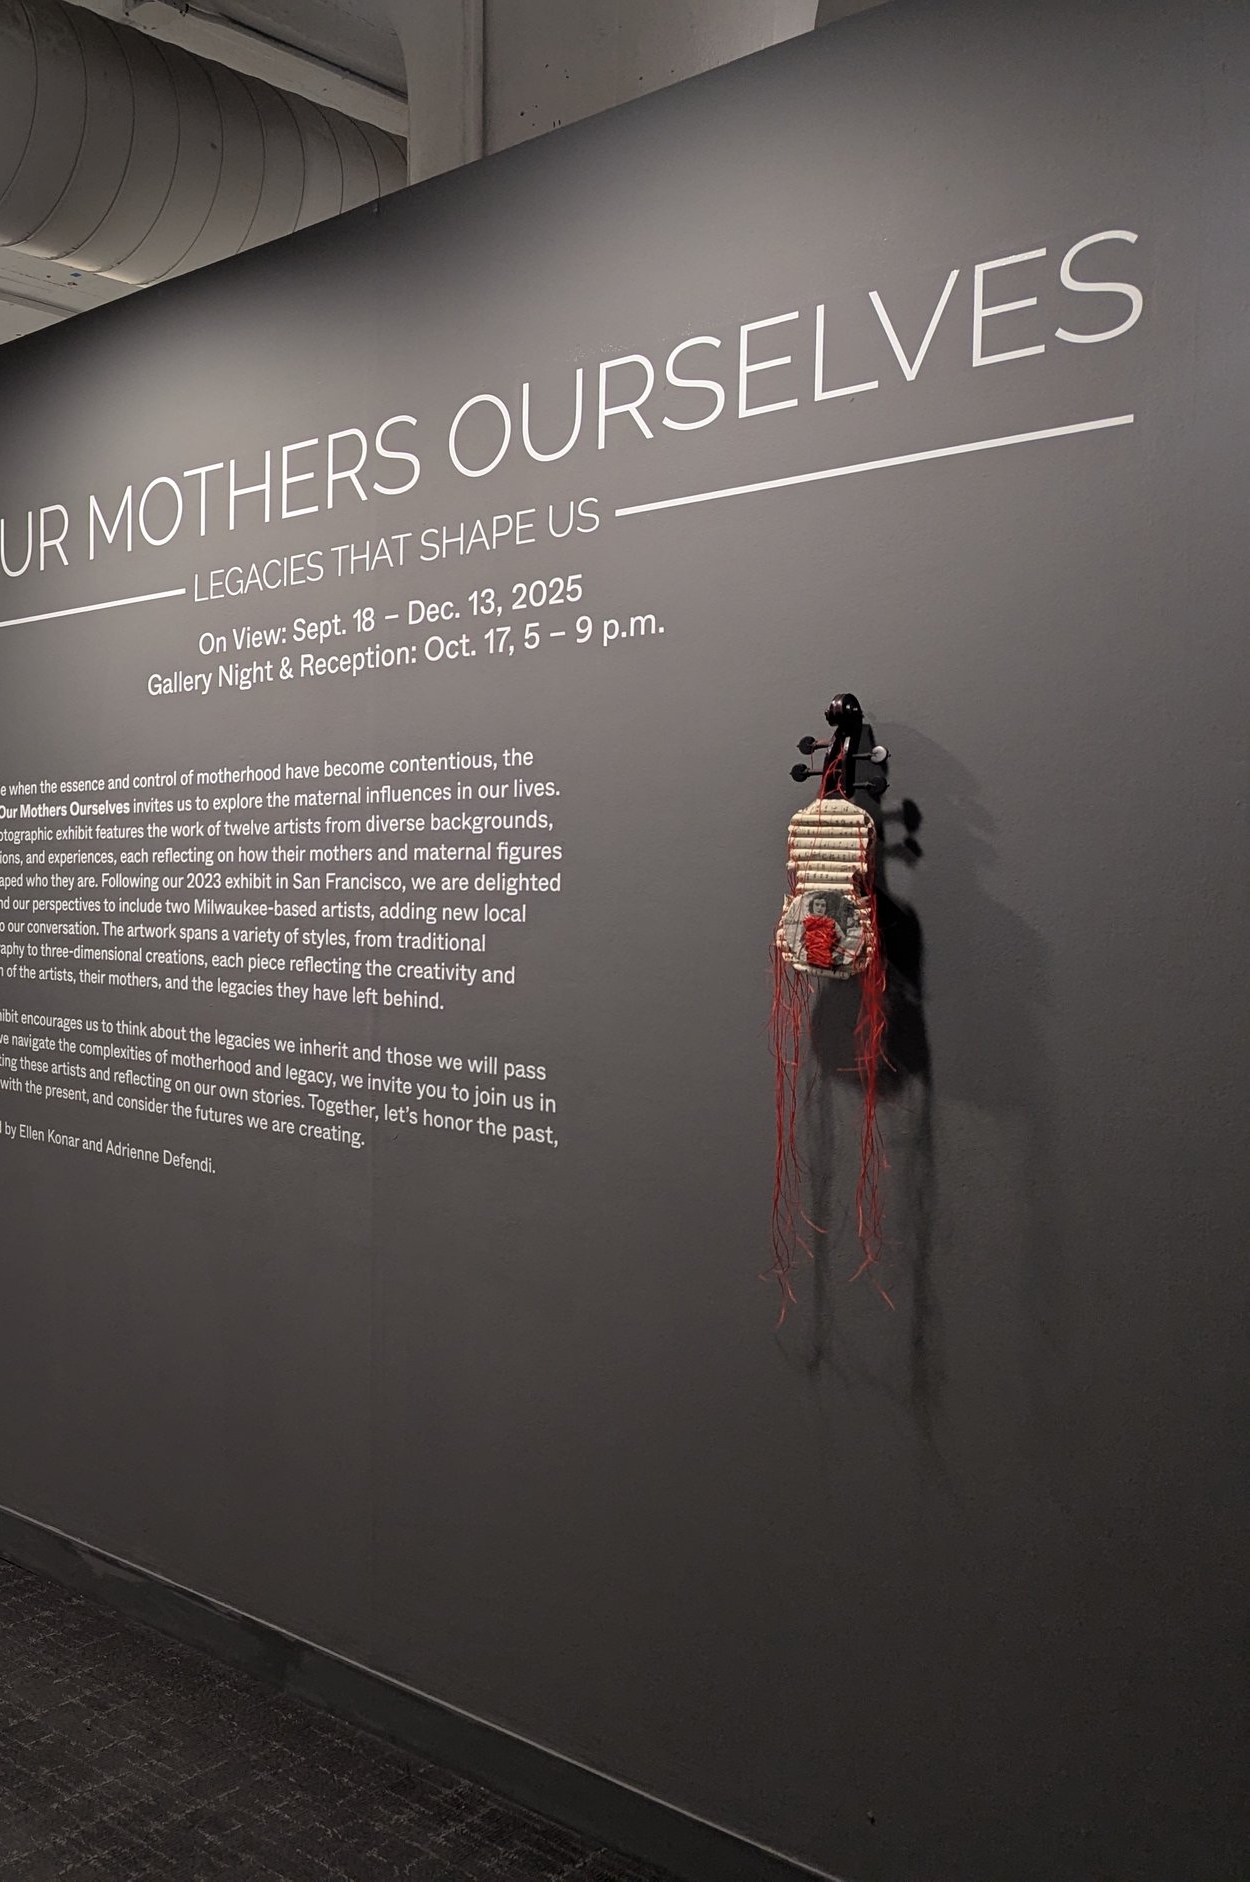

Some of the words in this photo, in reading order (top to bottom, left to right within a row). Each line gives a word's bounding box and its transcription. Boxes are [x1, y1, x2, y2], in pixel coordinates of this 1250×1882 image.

[90, 415, 420, 560] MOTHERS
[449, 230, 1143, 477] OURSELVES
[195, 551, 323, 602] LEGACIES
[331, 533, 412, 576] THAT
[420, 508, 536, 561] SHAPE
[549, 497, 599, 537] US
[199, 633, 226, 655] On
[233, 626, 286, 650] View:
[293, 614, 346, 644] Sept.
[353, 607, 375, 632] 18
[409, 600, 460, 625] Dec.
[468, 588, 502, 617] 13,
[512, 574, 582, 610] 2025
[148, 671, 212, 695] Gallery
[219, 661, 273, 690] Night
[279, 657, 294, 680] &
[301, 644, 416, 677] Reception:
[425, 634, 476, 661] Oct.
[484, 626, 514, 656] 17,
[524, 622, 540, 649] 5
[576, 616, 592, 643] 9
[603, 614, 664, 646] p.m.
[9, 781, 37, 795] when
[40, 780, 57, 794] the
[60, 779, 105, 793] essence
[108, 774, 129, 790] and
[133, 771, 176, 788] control
[180, 769, 194, 785] of
[197, 764, 281, 784] motherhood
[286, 763, 319, 779] have
[324, 760, 384, 777] become
[390, 751, 497, 773] contentious,
[502, 748, 533, 766] the
[20, 803, 67, 818] Mothers
[70, 800, 130, 816] Ourselves
[133, 798, 173, 813] invites
[177, 799, 192, 811] us
[195, 796, 209, 810] to
[213, 793, 263, 813] explore
[266, 791, 290, 807] the
[295, 787, 361, 806] maternal
[366, 785, 451, 803] influences
[457, 782, 472, 799] in
[478, 784, 509, 799] our
[514, 779, 560, 797] lives.
[56, 825, 93, 840] exhibit
[95, 825, 144, 839] features
[147, 823, 167, 838] the
[171, 821, 204, 837] work
[207, 820, 221, 836] of
[224, 819, 270, 835] twelve
[274, 818, 321, 834] artists
[325, 817, 361, 833] from
[366, 815, 425, 832] diverse
[431, 810, 553, 834] backgrounds,
[26, 850, 45, 864] and
[48, 849, 117, 867] experiences,
[120, 848, 148, 863] each
[152, 847, 214, 866] reflecting
[217, 851, 234, 862] on
[239, 846, 268, 862] how
[271, 845, 306, 862] their
[310, 844, 373, 861] mothers
[378, 843, 408, 861] and
[414, 842, 491, 860] maternal
[496, 842, 562, 864] figures
[13, 899, 30, 910] our
[33, 897, 101, 914] perspectives
[103, 898, 116, 912] to
[119, 897, 162, 913] include
[165, 899, 190, 914] two
[194, 899, 316, 917] Milwaukee-based
[322, 901, 374, 921] artists,
[380, 902, 437, 924] adding
[443, 907, 479, 921] new
[485, 903, 526, 922] local
[7, 964, 17, 977] of
[19, 965, 36, 979] the
[39, 967, 76, 984] artists,
[79, 969, 106, 984] their
[109, 972, 161, 989] mothers,
[165, 975, 188, 990] and
[191, 976, 213, 992] the
[218, 977, 273, 998] legacies
[276, 982, 309, 1003] they
[313, 984, 347, 1002] have
[353, 986, 378, 1005] left
[384, 988, 444, 1009] behind.
[27, 943, 38, 956] to
[40, 943, 142, 962] three-dimensional
[145, 949, 208, 968] creations,
[212, 952, 243, 968] each
[248, 953, 285, 972] piece
[290, 956, 362, 979] reflecting
[365, 959, 392, 977] the
[397, 962, 477, 986] creativity
[482, 966, 515, 984] and
[12, 1034, 55, 1052] navigate
[58, 1038, 76, 1053] the
[79, 1043, 152, 1062] complexities
[155, 1049, 168, 1064] of
[171, 1053, 251, 1074] motherhood
[255, 1062, 281, 1078] and
[286, 1064, 336, 1088] legacy,
[340, 1074, 363, 1088] we
[368, 1073, 412, 1094] invite
[416, 1083, 446, 1100] you
[451, 1084, 469, 1102] to
[473, 1085, 506, 1107] join
[513, 1095, 534, 1110] us
[540, 1093, 556, 1113] in
[19, 1056, 48, 1072] these
[51, 1062, 86, 1078] artists
[89, 1067, 110, 1081] and
[114, 1069, 172, 1093] reflecting
[175, 1080, 190, 1092] on
[194, 1082, 216, 1096] our
[219, 1086, 248, 1100] own
[252, 1088, 304, 1108] stories.
[308, 1093, 379, 1122] Together,
[385, 1104, 418, 1124] let’s
[423, 1109, 473, 1132] honor
[477, 1117, 507, 1137] the
[513, 1125, 558, 1148] past,
[5, 1121, 17, 1139] by
[20, 1124, 44, 1141] Ellen
[48, 1129, 80, 1147] Konar
[82, 1138, 103, 1152] and
[106, 1140, 159, 1163] Adrienne
[163, 1150, 215, 1173] Defendi.
